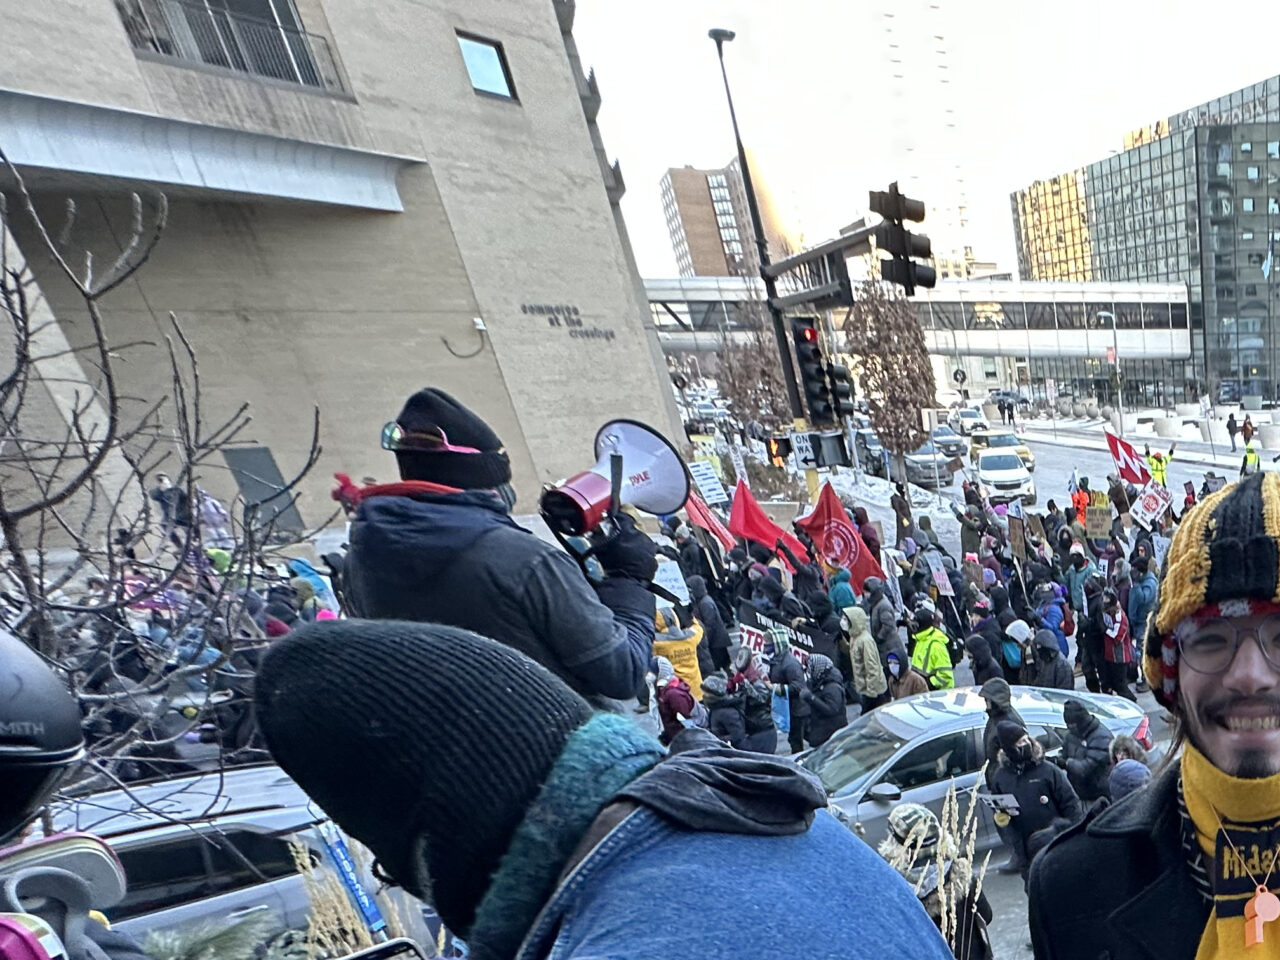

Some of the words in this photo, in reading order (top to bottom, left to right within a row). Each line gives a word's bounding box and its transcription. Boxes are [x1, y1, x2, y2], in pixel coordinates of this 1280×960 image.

[795, 434, 811, 445] ON
[797, 444, 812, 454] WA
[629, 470, 650, 486] PYLE
